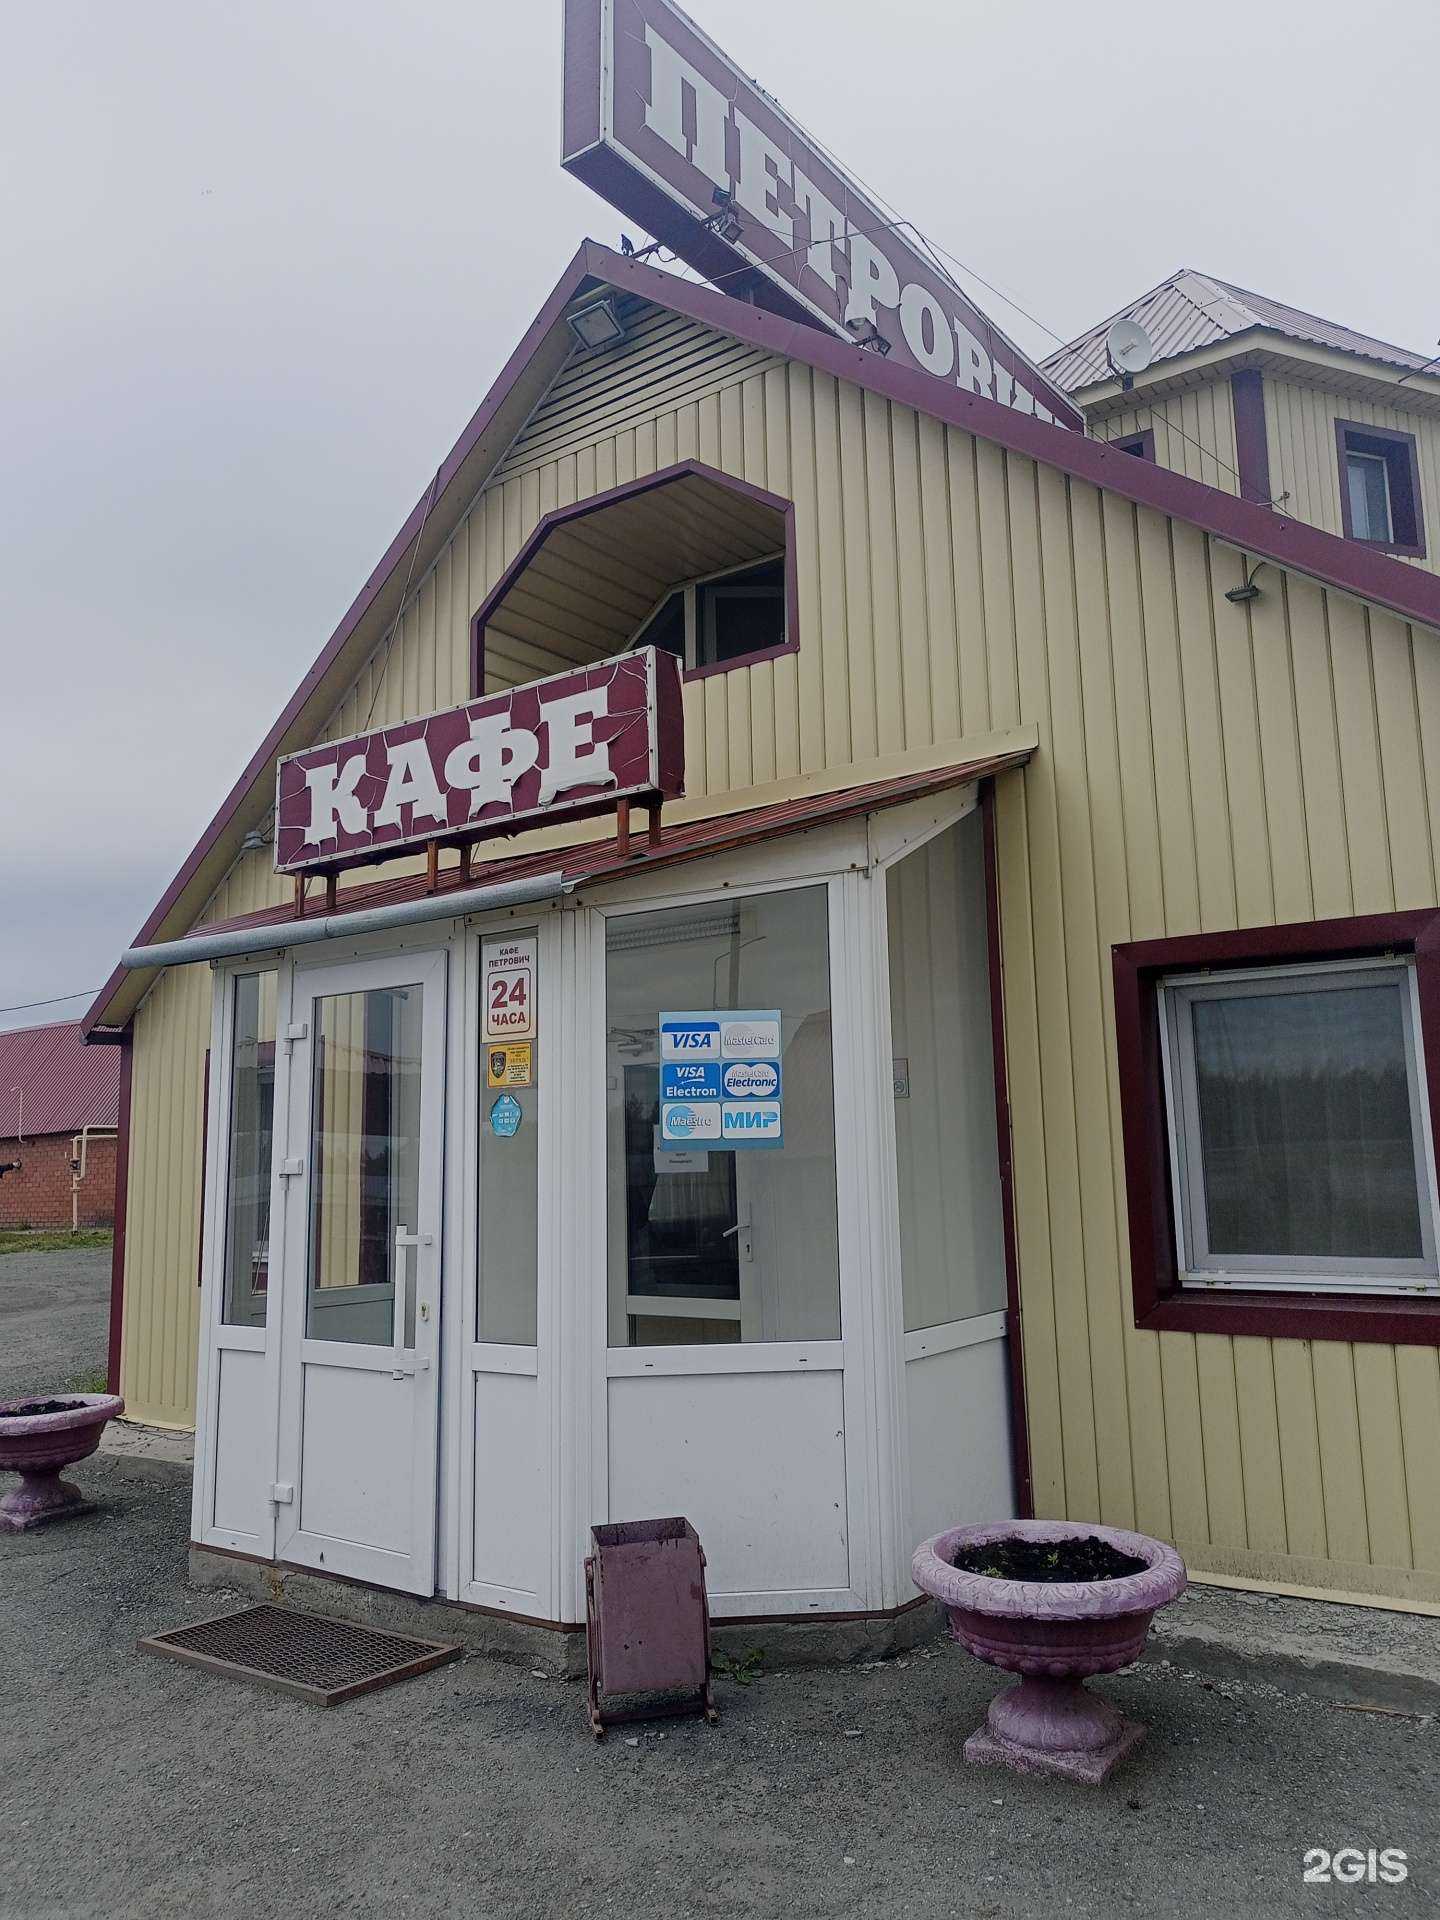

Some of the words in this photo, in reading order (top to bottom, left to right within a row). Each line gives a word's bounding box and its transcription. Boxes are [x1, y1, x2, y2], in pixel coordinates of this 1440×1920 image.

[643, 21, 1072, 432] ПЕТРОВИ
[304, 686, 614, 844] КАФЕ
[500, 946, 519, 956] КАФЕ
[488, 955, 530, 968] ПЕТРОВИЧ
[491, 977, 527, 1009] 24
[491, 1011, 526, 1026] ЧАСА
[671, 1033, 712, 1049] VISA
[676, 1066, 705, 1077] VISA
[726, 1077, 777, 1088] Electronic
[666, 1086, 717, 1097] Electron
[724, 1111, 779, 1129] МИР
